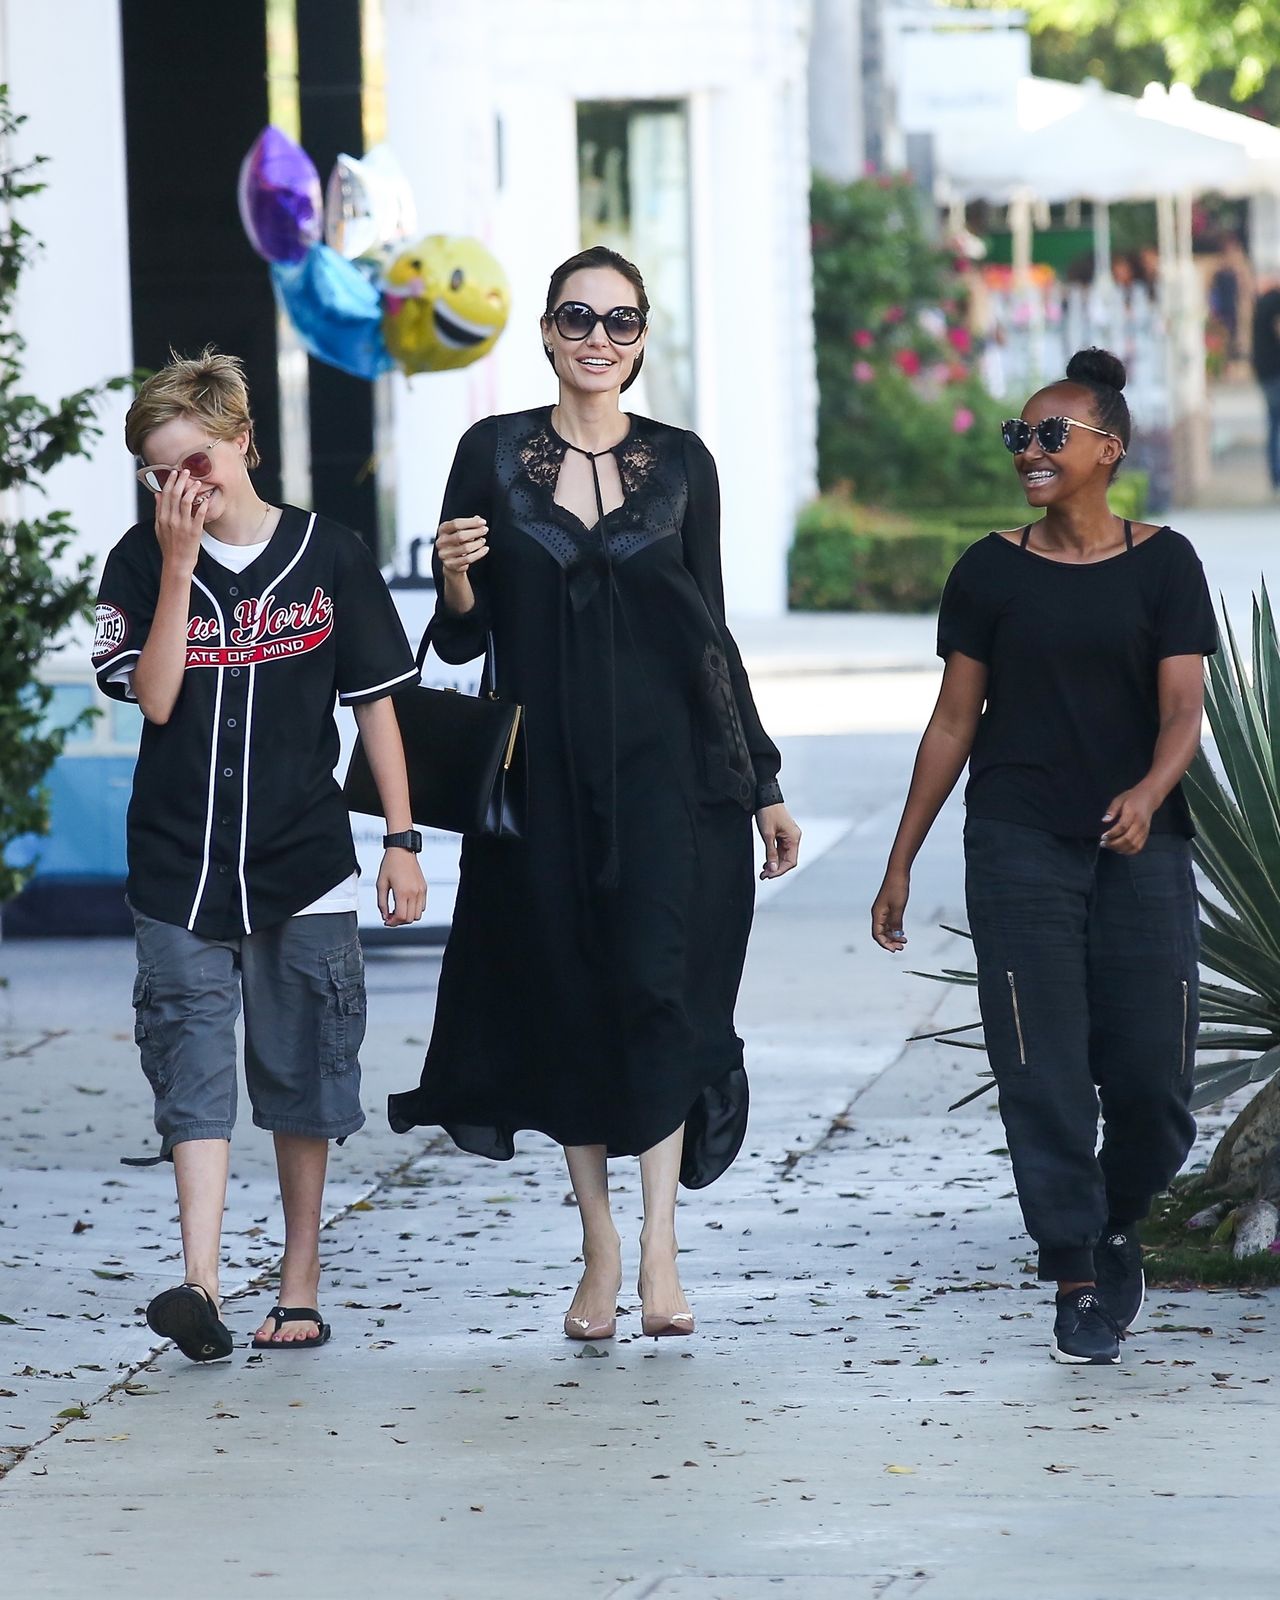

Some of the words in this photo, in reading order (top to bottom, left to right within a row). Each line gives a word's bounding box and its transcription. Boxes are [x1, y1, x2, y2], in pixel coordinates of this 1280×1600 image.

[230, 587, 333, 646] York
[100, 617, 123, 644] JOEL
[186, 651, 219, 662] ATE
[262, 639, 305, 658] MIND
